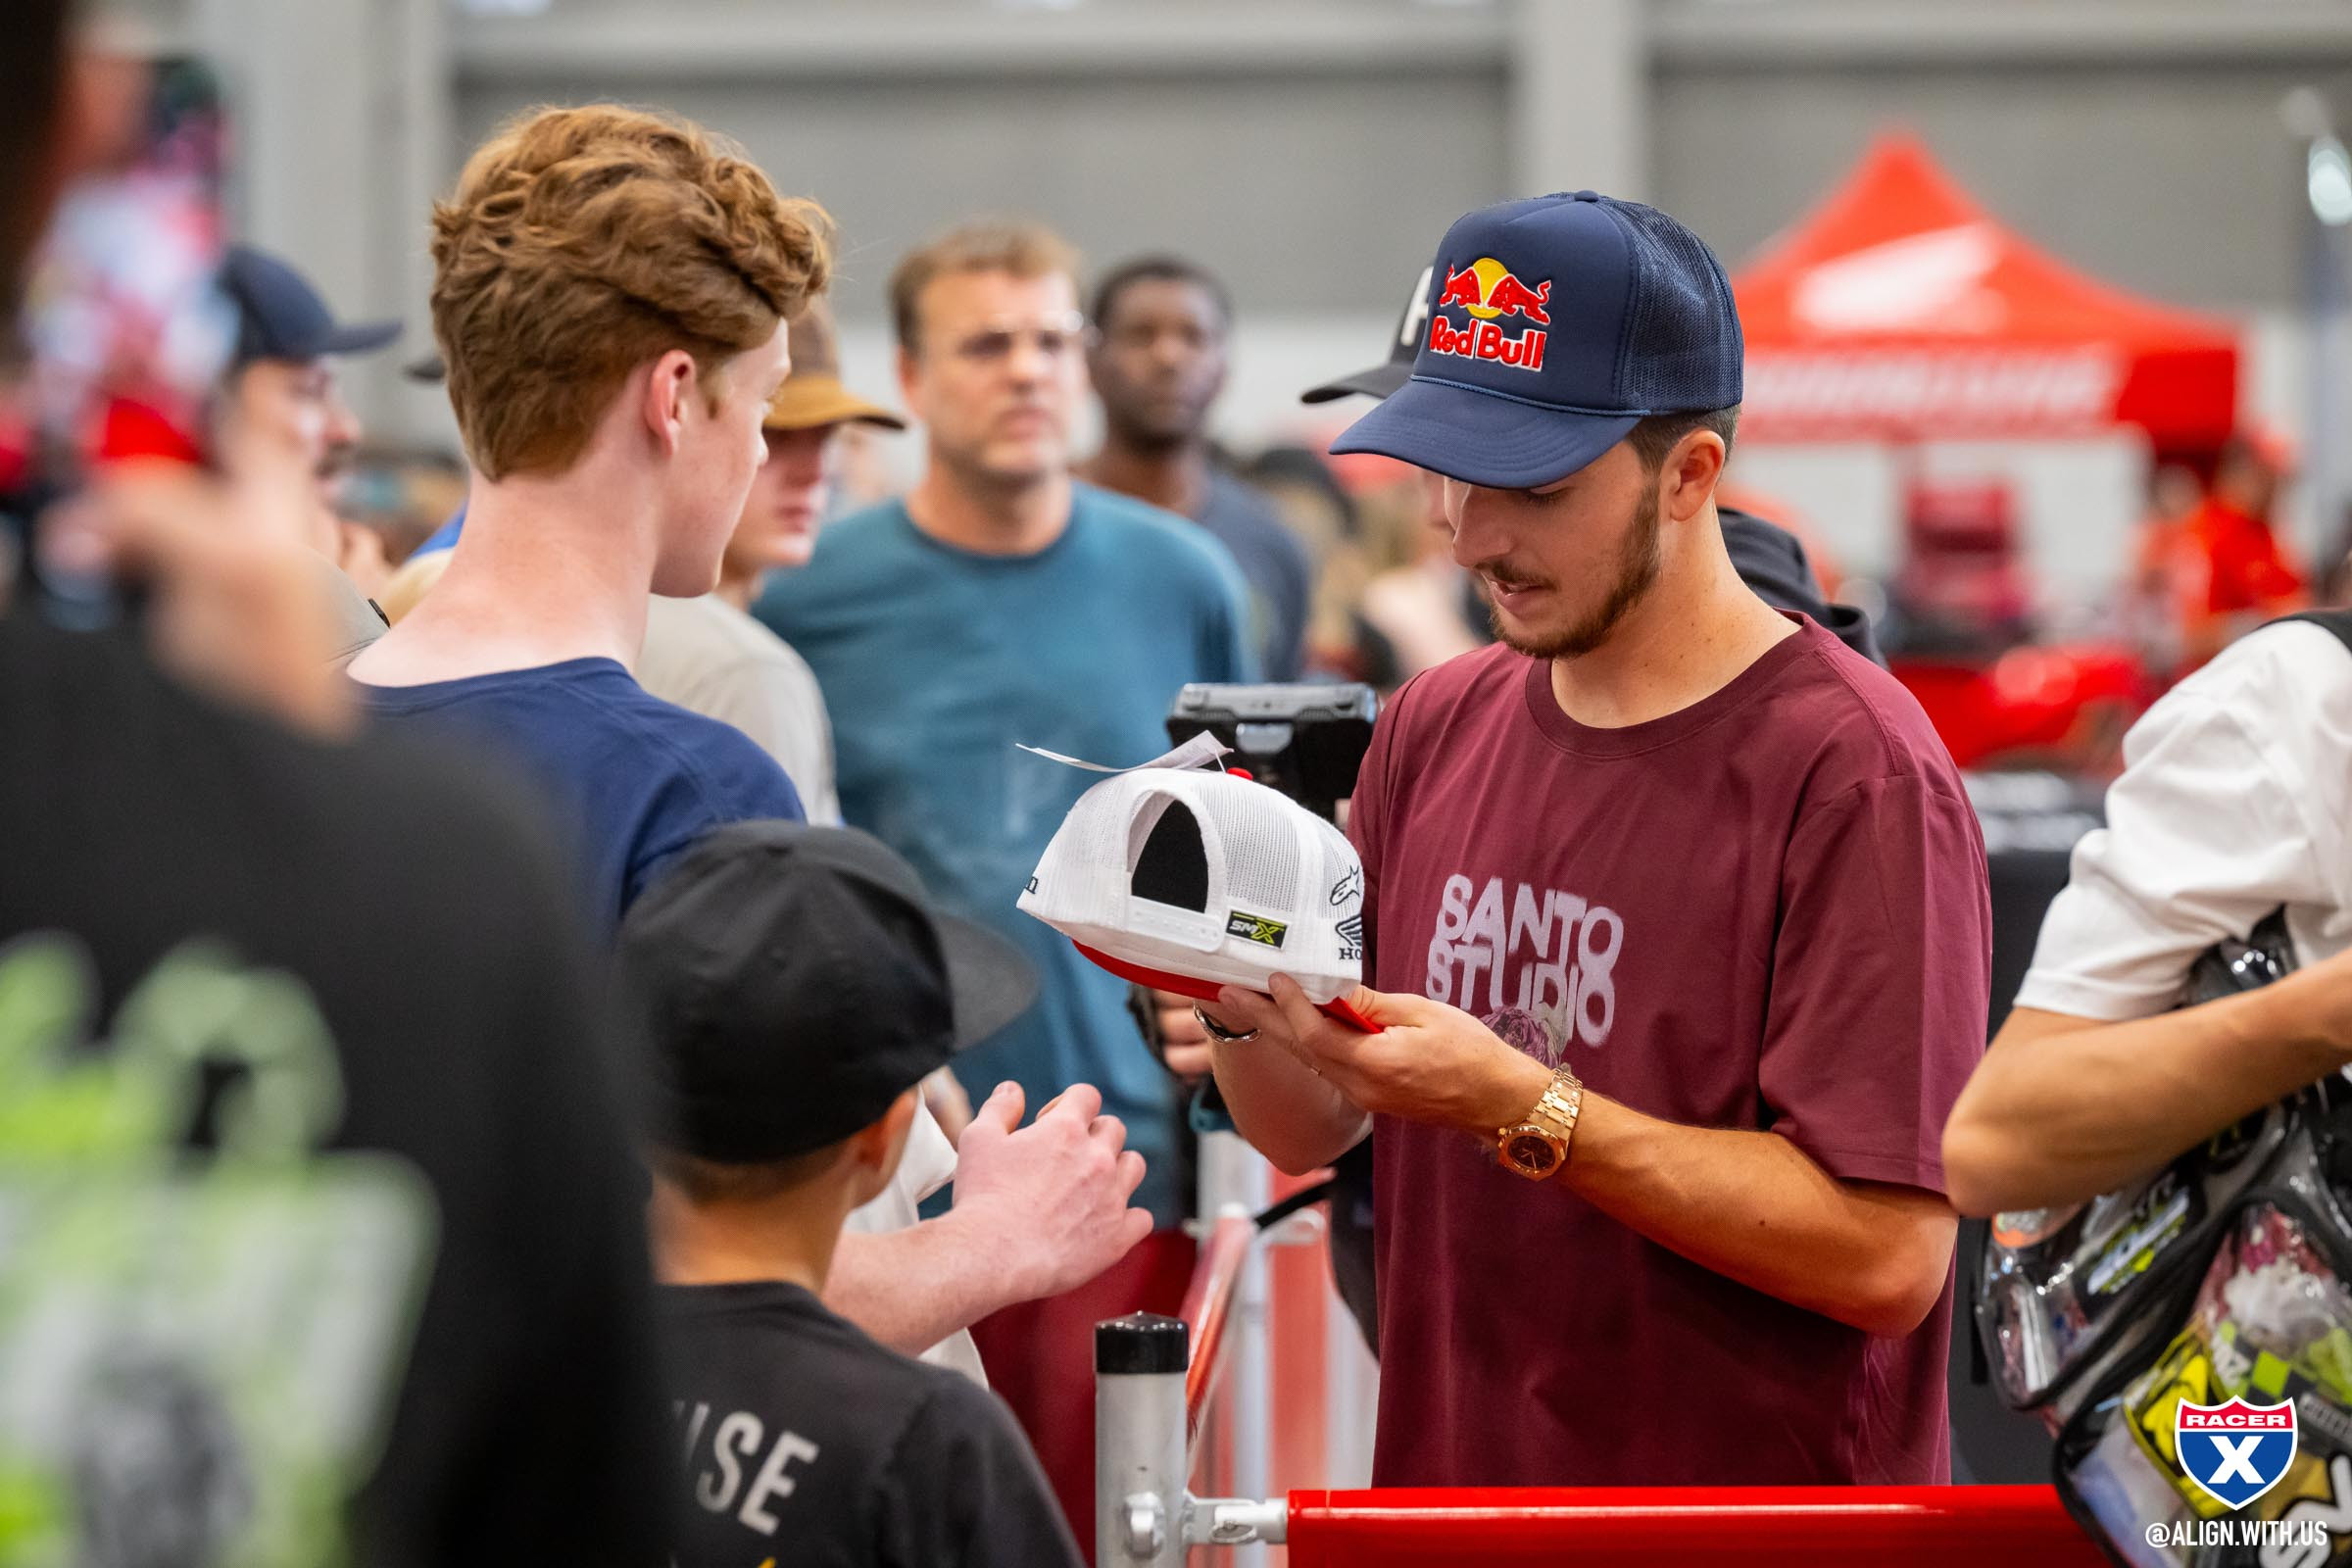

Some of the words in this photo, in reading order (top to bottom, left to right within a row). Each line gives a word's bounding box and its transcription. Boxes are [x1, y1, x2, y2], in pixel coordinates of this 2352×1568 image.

[1429, 316, 1478, 359] Red
[1475, 321, 1546, 371] Bull
[1229, 919, 1279, 945] SMX
[1437, 873, 1624, 972] SANTO
